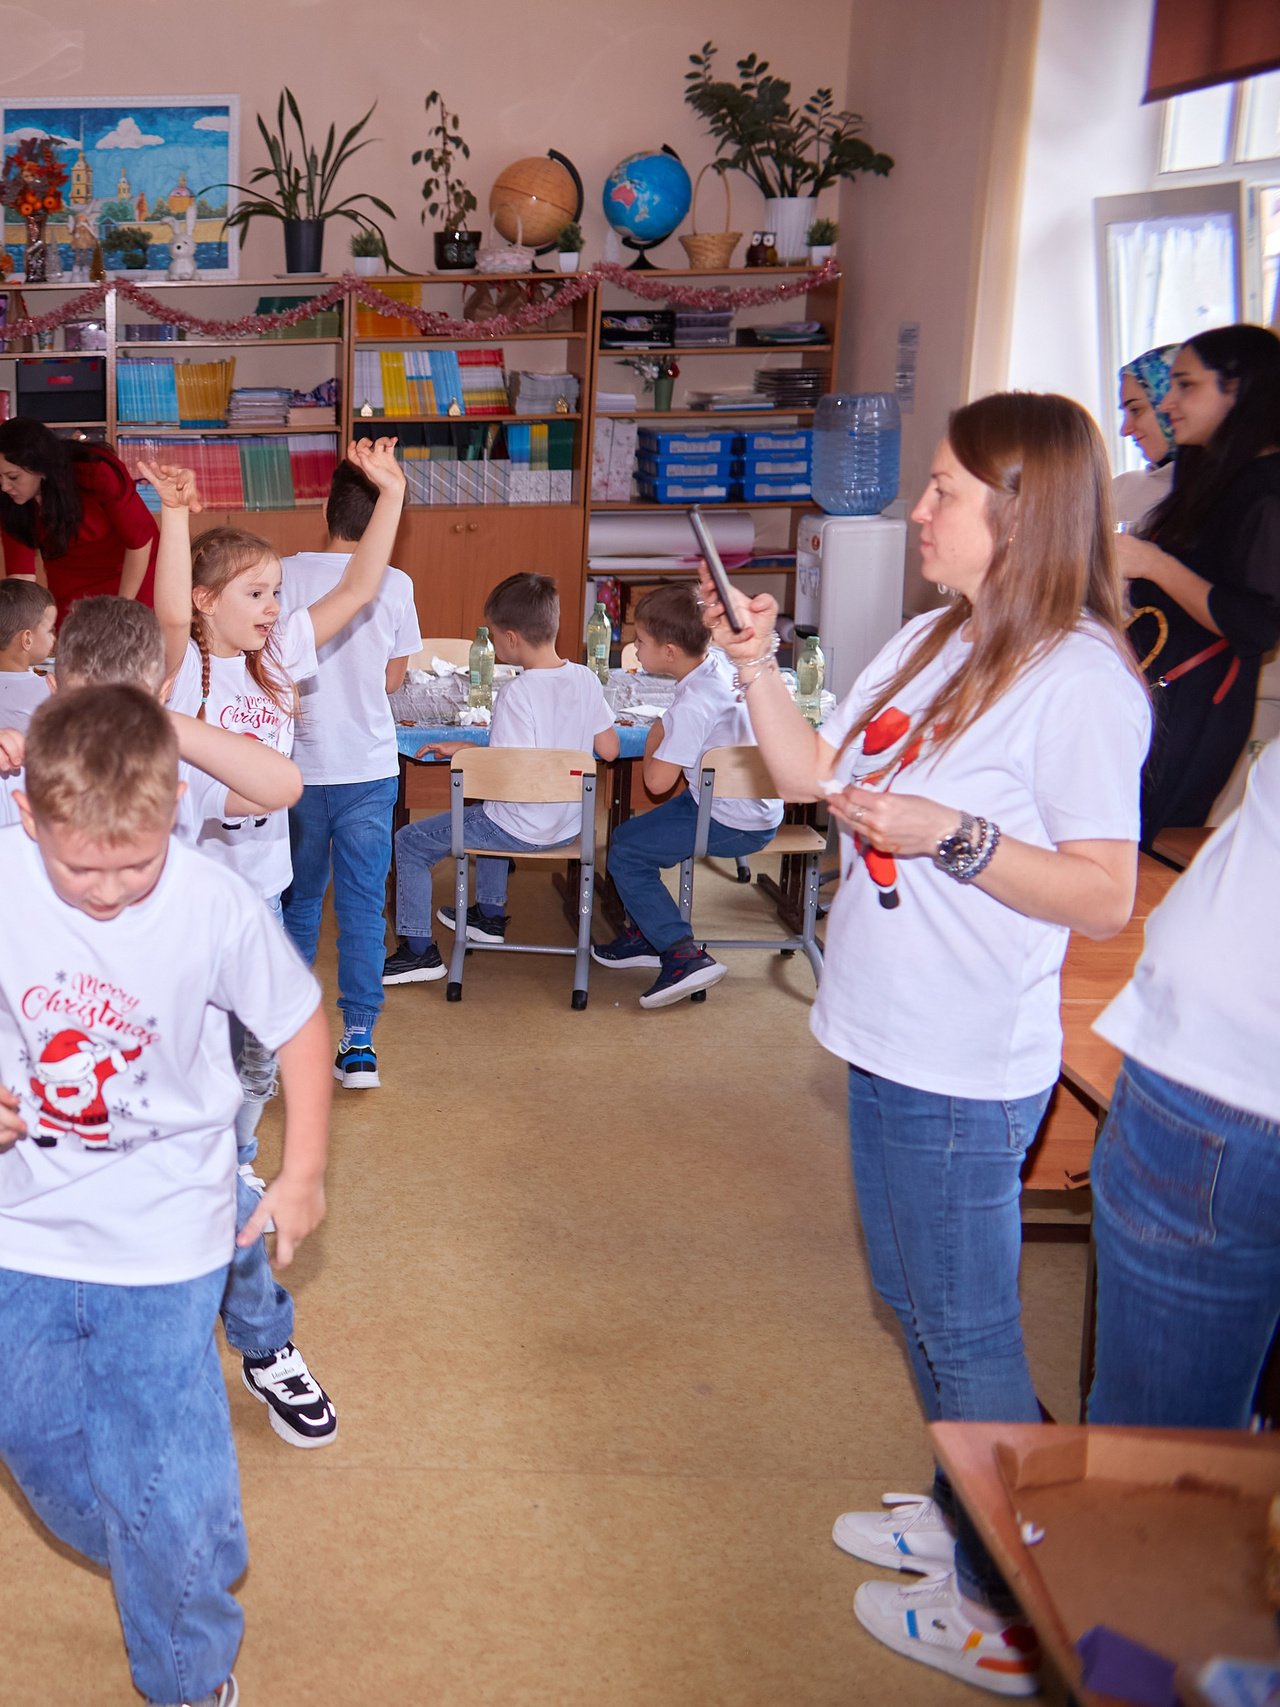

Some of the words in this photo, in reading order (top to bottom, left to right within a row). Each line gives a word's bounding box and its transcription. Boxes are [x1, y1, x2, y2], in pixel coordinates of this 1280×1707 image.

[220, 705, 279, 729] Christm
[71, 972, 141, 1014] Merry
[21, 985, 162, 1047] Christmas
